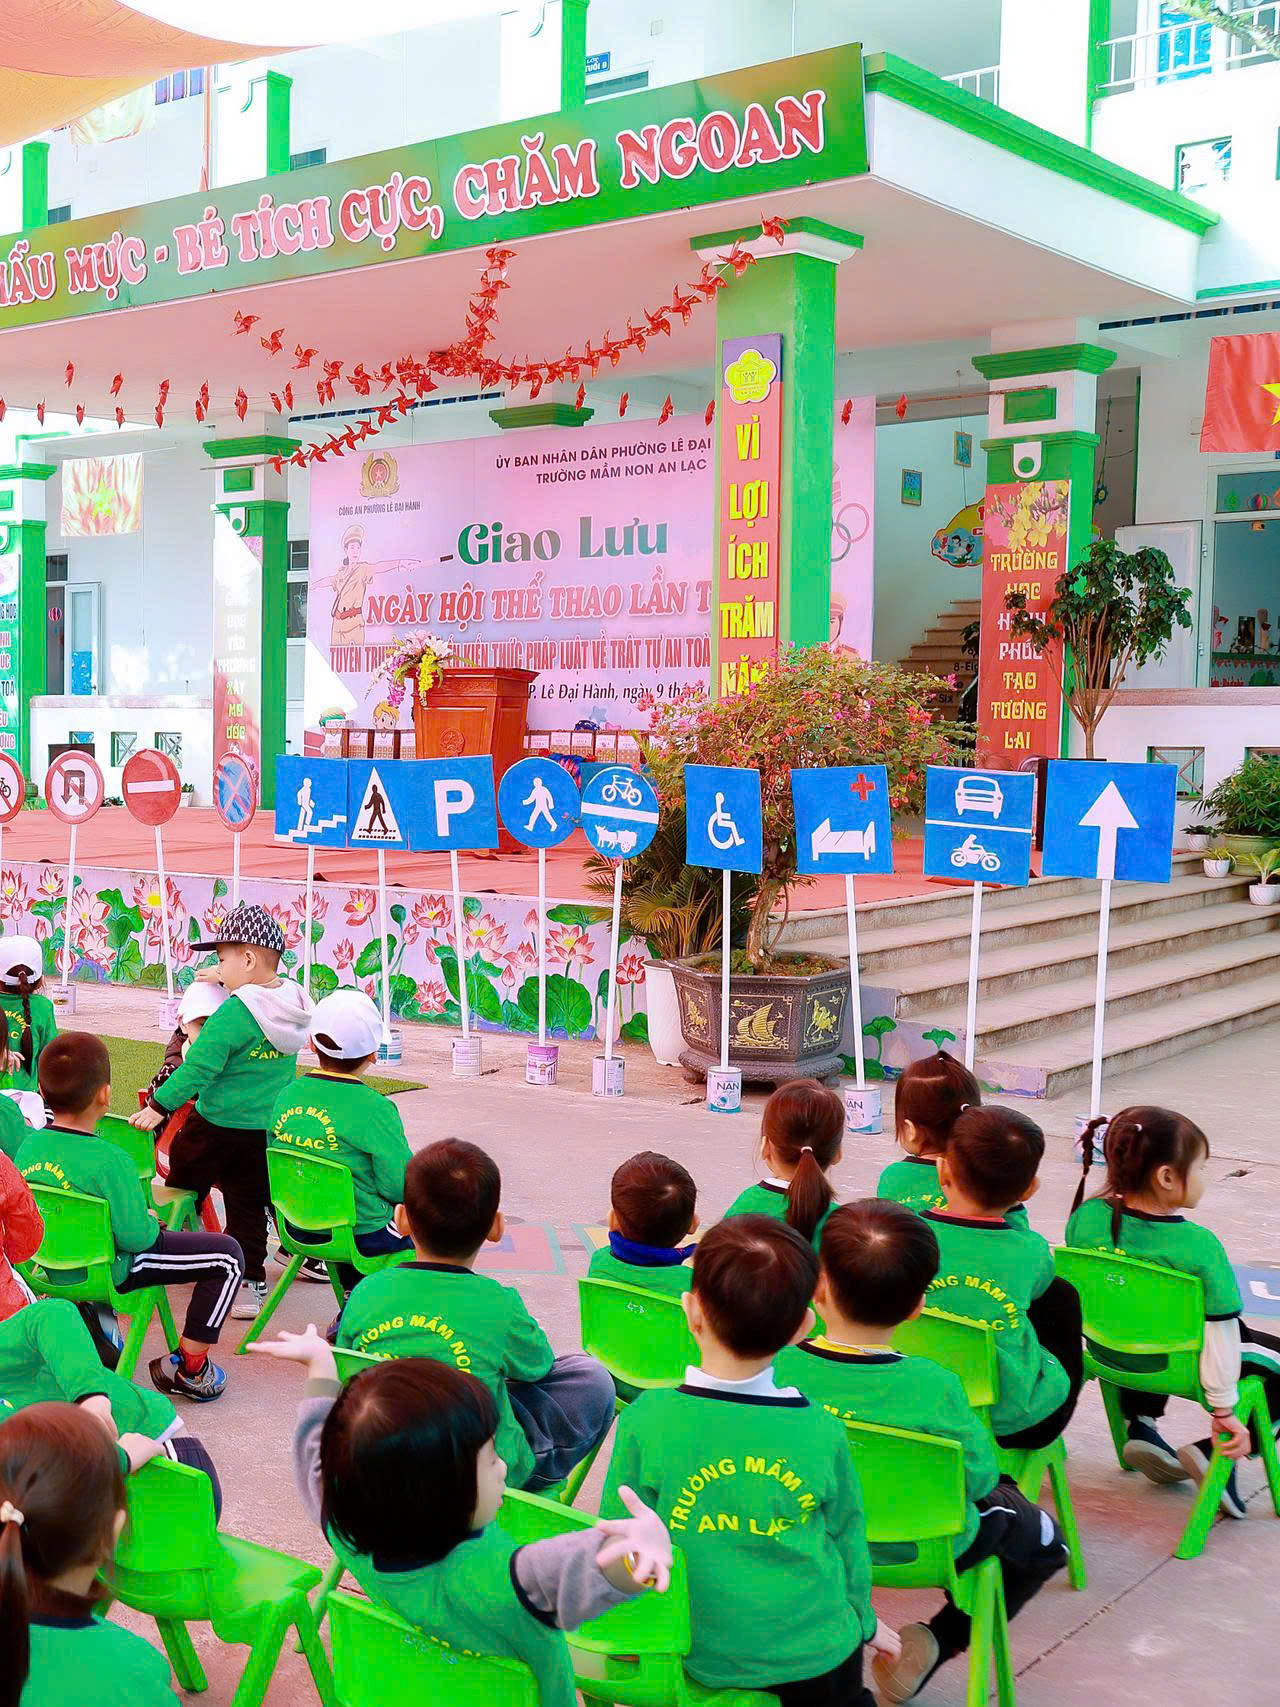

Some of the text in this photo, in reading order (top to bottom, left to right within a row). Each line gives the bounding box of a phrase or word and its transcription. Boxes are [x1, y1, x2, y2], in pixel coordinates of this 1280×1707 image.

[66, 231, 148, 301] MỰC
[174, 206, 228, 275] BÉ
[233, 193, 331, 261] TÍCH
[338, 171, 444, 254] CỰC,
[454, 132, 600, 221] CHĂM
[618, 90, 825, 189] NGOAN
[735, 415, 761, 461] VÌ
[496, 438, 713, 469] ỦY BAN NHÂN DÂN PHƯỜNG LÊ ĐẠI
[536, 457, 708, 485] TRƯỜNG MẦM NON AN LẠC
[338, 504, 354, 516] CÔNG
[355, 505, 362, 515] AN
[363, 503, 386, 514] PHƯỜNG
[387, 502, 393, 512] LÊ
[405, 501, 421, 511] HÀNH
[729, 480, 770, 528] LỢI
[457, 515, 668, 565] Giao Lưu
[728, 534, 769, 580] ÍCH
[990, 548, 1058, 573] TRƯỜNG
[5, 603, 17, 623] HỌC
[366, 590, 434, 625] NGÀY
[439, 582, 483, 631] HỘI
[491, 571, 547, 621] THỂ
[549, 584, 624, 618] THAO
[720, 594, 774, 639] TRĂM
[330, 643, 362, 672] TUYÊN
[526, 633, 558, 669] PHÁP
[560, 638, 589, 674] LUẬT
[591, 630, 608, 668] VỀ
[610, 636, 642, 674] TRẬT
[644, 633, 664, 673] TỰ
[665, 638, 682, 667] AN
[541, 684, 555, 699] Lê
[558, 684, 579, 703] Đại
[583, 683, 619, 701] Hành,
[656, 684, 664, 697] 9
[1002, 671, 1037, 694] TẠO
[990, 699, 1048, 721] TƯƠNG
[1004, 731, 1031, 749] LAI
[433, 778, 475, 837] P
[717, 1080, 740, 1091] NAN
[306, 1106, 339, 1151] MẦM NON
[295, 1136, 325, 1151] LẠC
[965, 1276, 1006, 1302] MẦM
[409, 1314, 455, 1340] MẦM
[669, 1458, 737, 1531] TRƯỜNG
[744, 1455, 803, 1492] MẦM
[698, 1513, 795, 1541] AN LẠC
